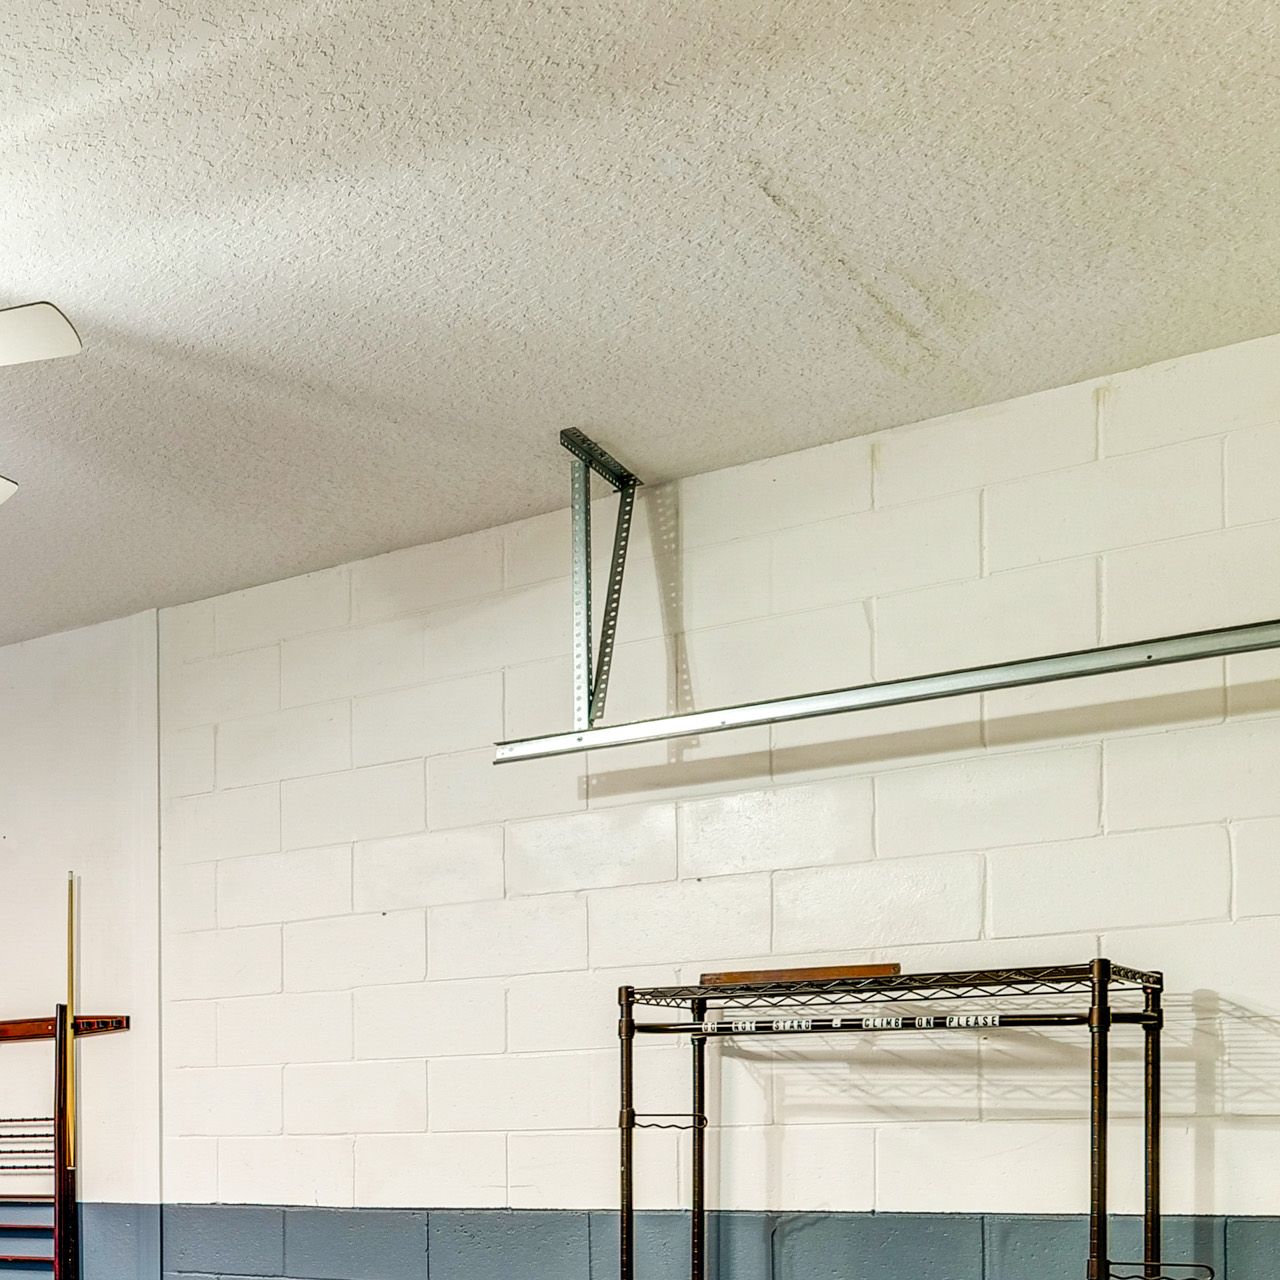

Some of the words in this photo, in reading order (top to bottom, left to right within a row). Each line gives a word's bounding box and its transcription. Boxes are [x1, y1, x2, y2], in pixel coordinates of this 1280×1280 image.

[863, 1017, 900, 1029] CLIMB
[916, 1016, 933, 1028] ON
[947, 1014, 998, 1028] PLEASE
